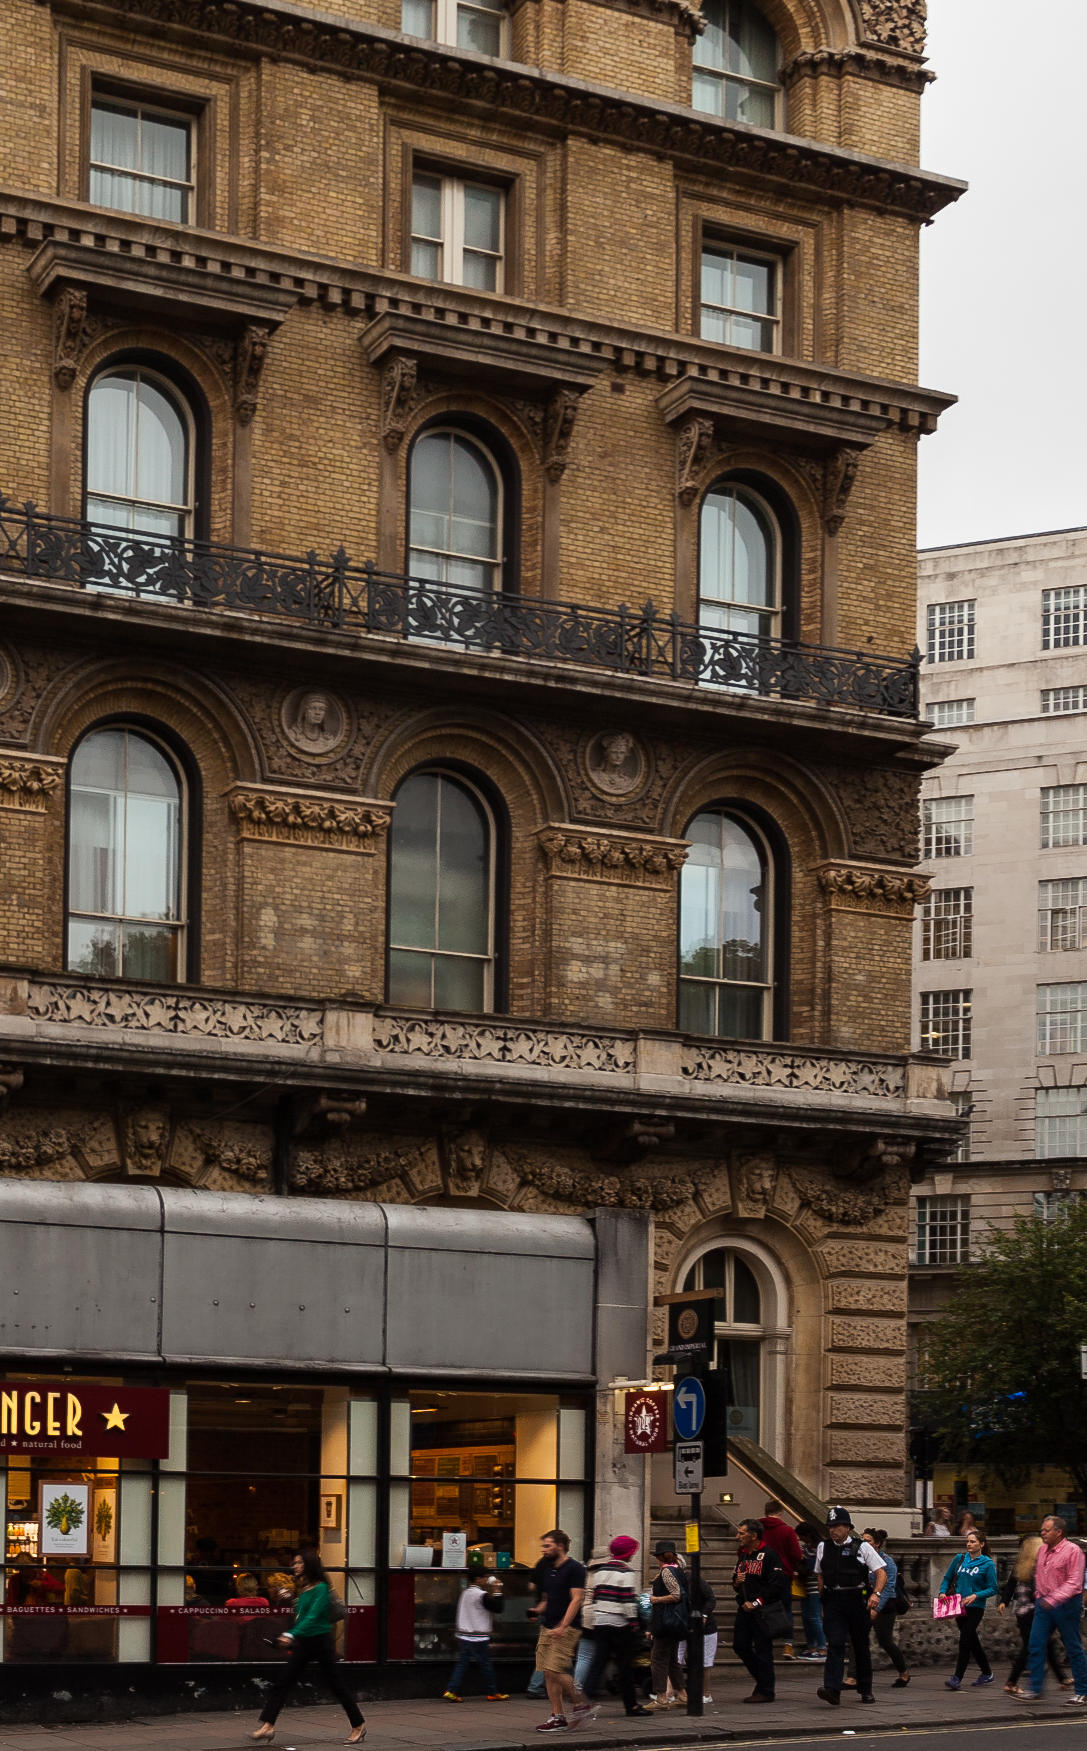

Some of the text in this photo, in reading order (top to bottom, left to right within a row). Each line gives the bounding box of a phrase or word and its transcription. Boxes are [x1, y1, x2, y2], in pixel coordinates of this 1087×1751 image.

[22, 1440, 57, 1449] natural
[61, 1440, 82, 1449] food
[66, 1606, 120, 1614] SANDWICHES
